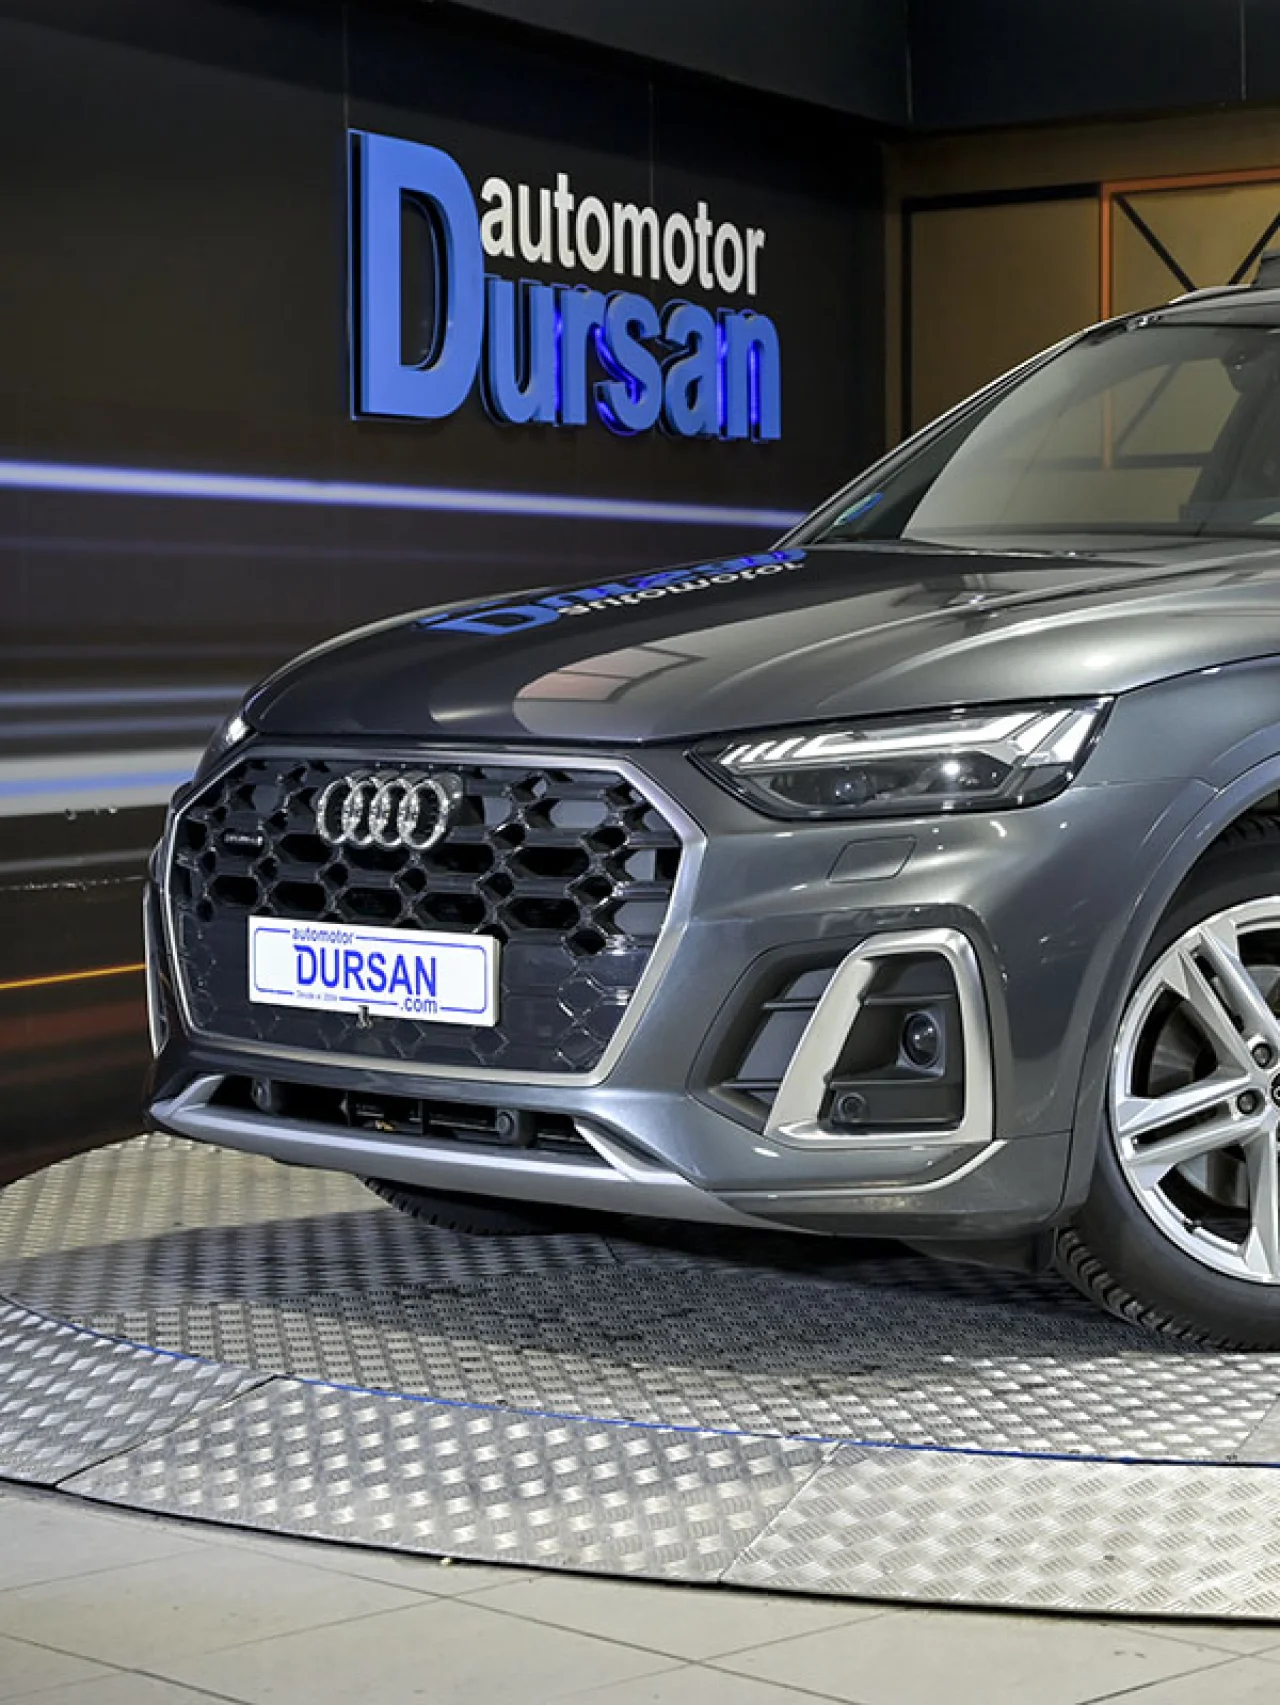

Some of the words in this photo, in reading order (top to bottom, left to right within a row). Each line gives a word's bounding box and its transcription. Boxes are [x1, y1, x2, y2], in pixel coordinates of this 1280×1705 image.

[481, 173, 765, 294] automotor
[348, 128, 781, 443] Dursan
[292, 928, 354, 944] automotor
[293, 945, 436, 997] DURSAN
[400, 998, 438, 1013] .com
